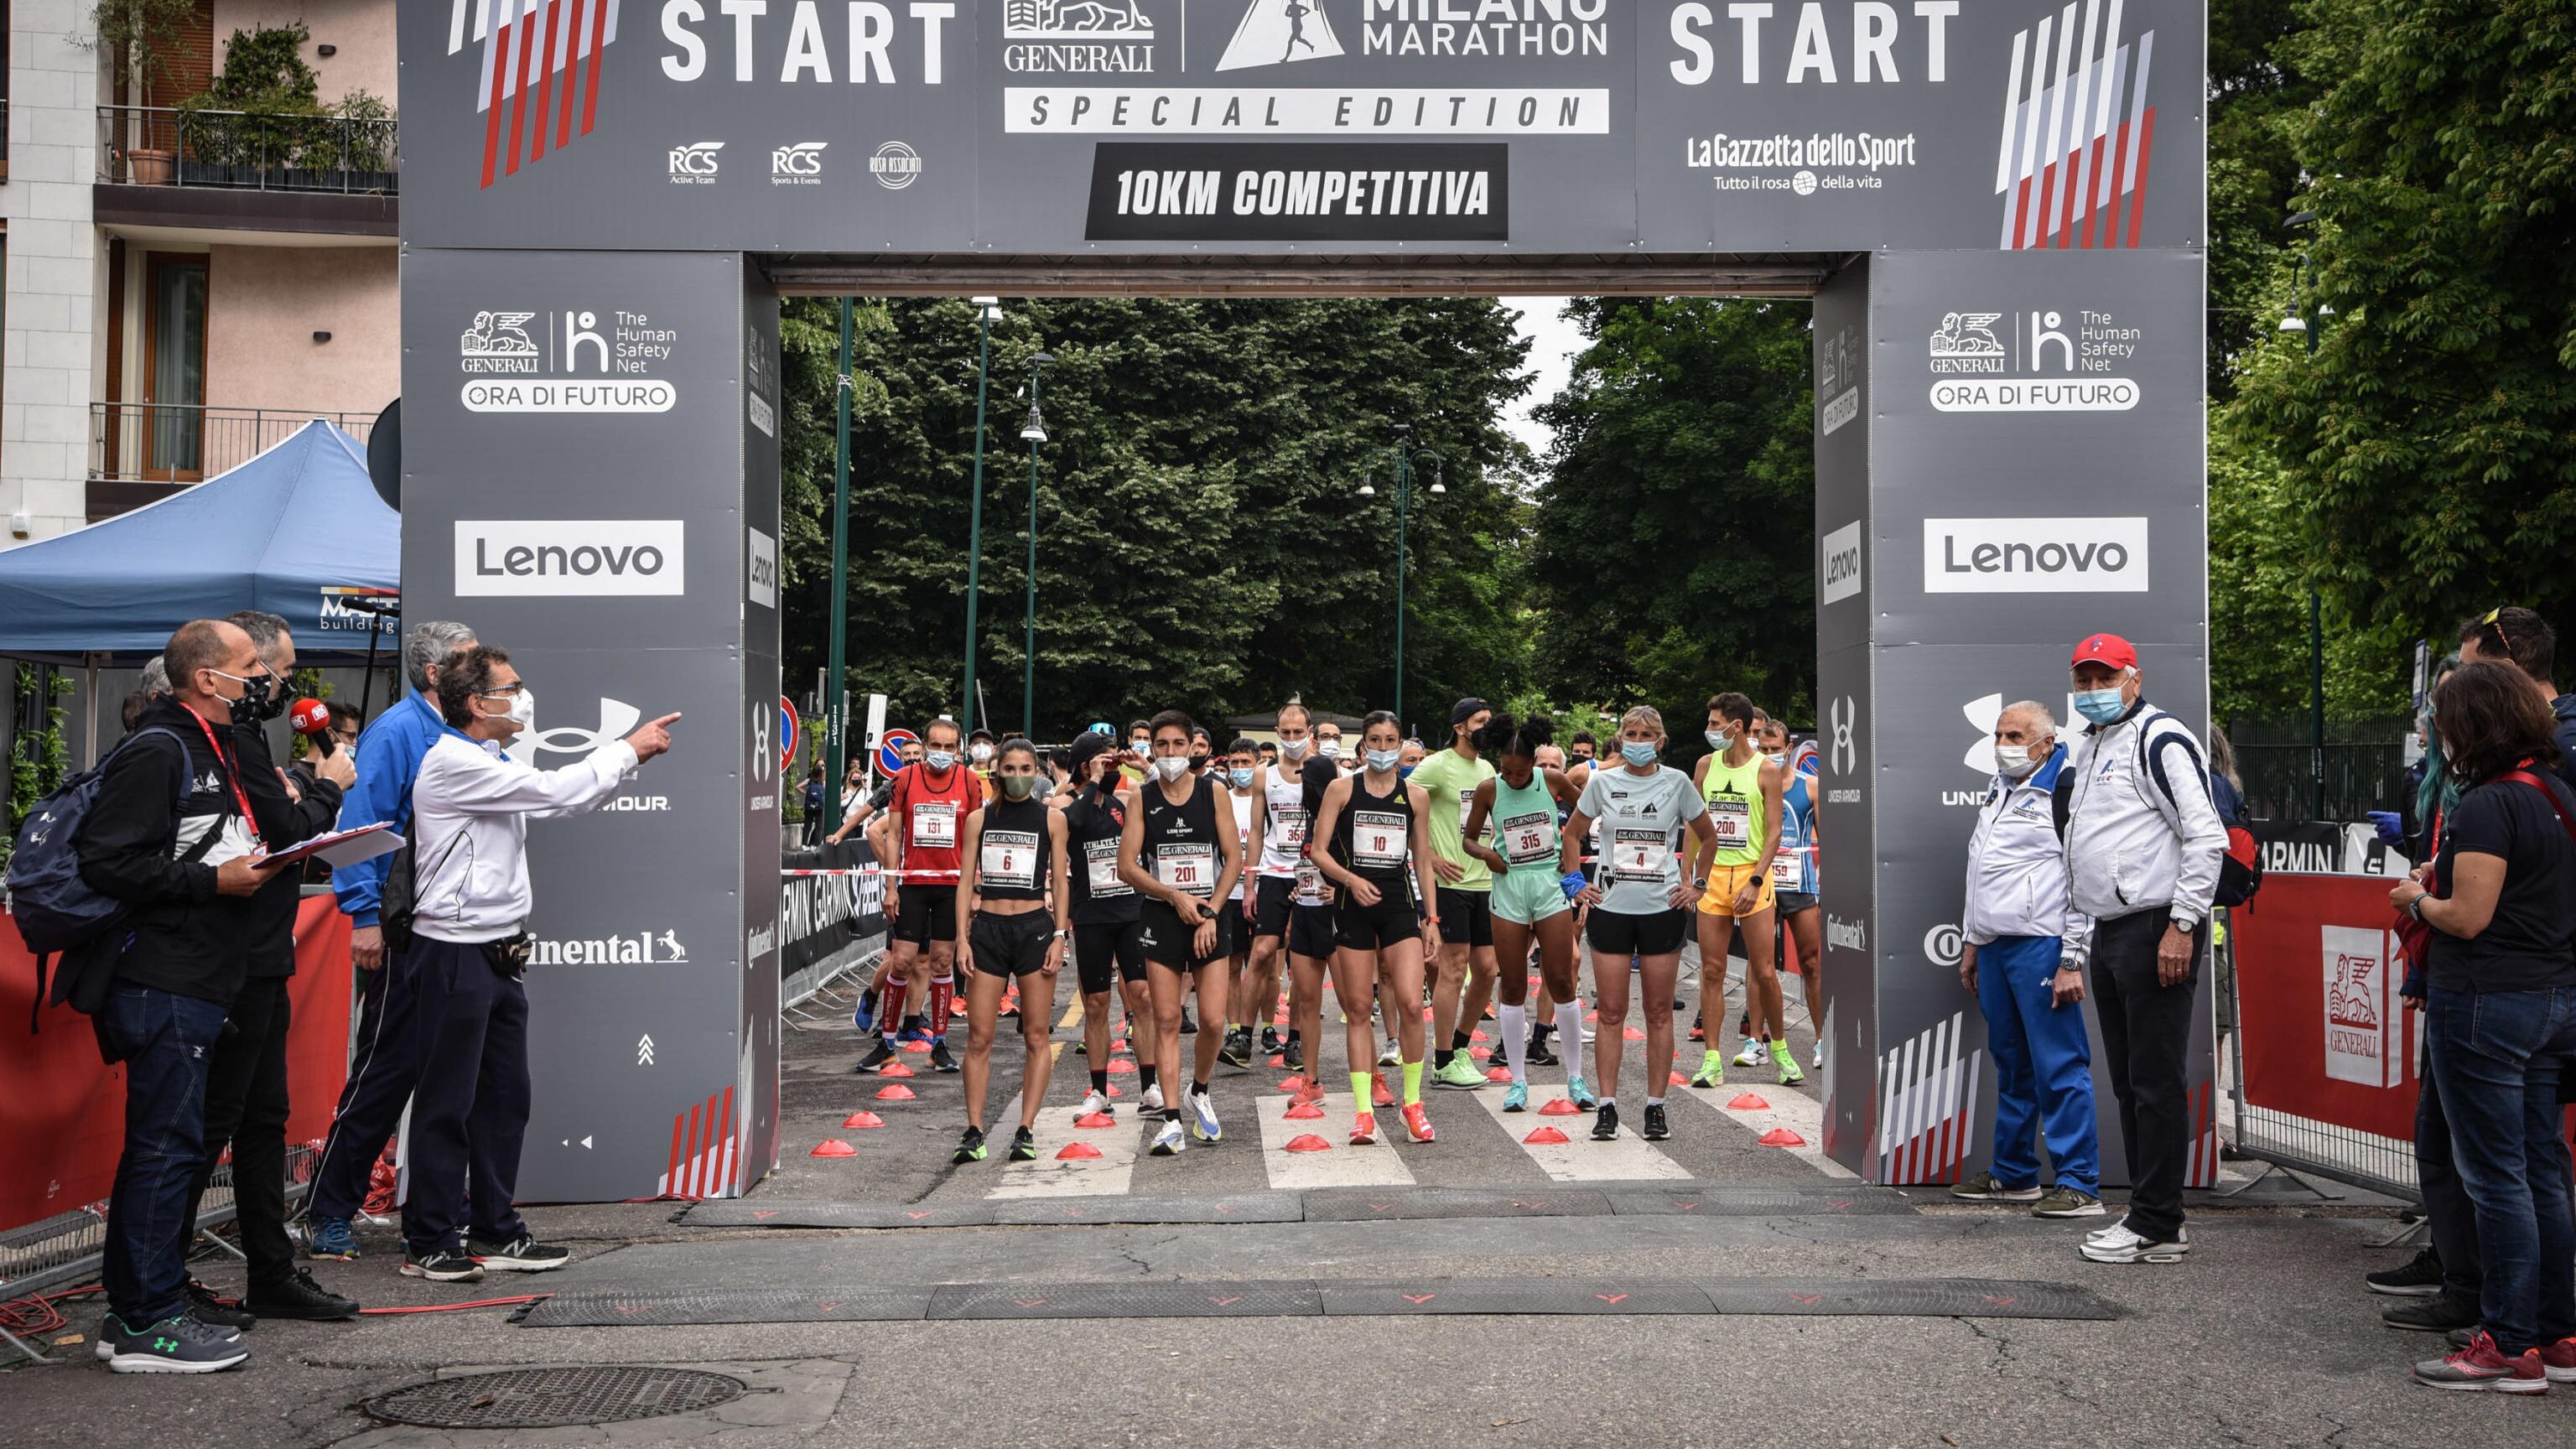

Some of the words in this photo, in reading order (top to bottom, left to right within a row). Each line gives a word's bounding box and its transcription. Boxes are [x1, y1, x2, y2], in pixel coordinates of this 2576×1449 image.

[661, 0, 955, 84] START
[1363, 23, 1607, 55] MARATHON
[1670, 1, 1959, 85] START
[1005, 45, 1154, 72] GENERALI
[1031, 96, 1280, 127] SPECIAL
[1335, 96, 1580, 127] EDITION
[1688, 138, 1711, 168] La
[1714, 132, 1802, 168] Gazzetta
[1806, 132, 1856, 167] dello
[1857, 132, 1916, 172] Sport
[668, 151, 719, 174] RCS
[771, 151, 821, 174] RCS
[870, 157, 886, 173] ROSA
[889, 157, 922, 173] ASSOCIATI
[670, 176, 693, 184] Active
[696, 176, 715, 184] Team
[771, 177, 792, 186] Sports
[801, 177, 821, 185] Events
[1714, 176, 1749, 190] Tutto
[1752, 175, 1759, 189] il
[1762, 178, 1790, 190] rosa
[1821, 174, 1853, 190] della
[1857, 175, 1883, 189] vita
[1118, 170, 1221, 216] 10KM
[1233, 170, 1488, 216] COMPETITIVA
[615, 311, 647, 325] The
[2080, 310, 2111, 325] The
[616, 328, 677, 341] Human
[2081, 326, 2140, 340] Human
[616, 342, 671, 361] Safety
[2080, 341, 2135, 359] Safety
[461, 358, 538, 373] GENERALI
[616, 359, 647, 373] Net
[1930, 358, 2005, 373] GENERALI
[2081, 357, 2111, 371] Net
[468, 386, 522, 406] ORA
[533, 386, 555, 406] DI
[565, 386, 668, 406] FUTURO
[1936, 385, 1989, 405] ORA
[1999, 386, 2021, 404] DI
[2031, 384, 2132, 404] FUTURO
[476, 538, 664, 576] Lenovo
[1944, 535, 2128, 574] Lenovo
[751, 543, 774, 589] Lenovo
[1826, 545, 1857, 586] Lenovo
[320, 617, 394, 634] building
[1828, 790, 1842, 802] UNDER
[1842, 789, 1861, 802] ARMOUR
[924, 806, 955, 814] GENERALI
[1716, 802, 1748, 812] GENERALI
[1368, 814, 1404, 825] GENERALI
[1514, 813, 1549, 825] GENERALI
[927, 822, 941, 834] 131
[1628, 830, 1665, 841] GENERALI
[1716, 821, 1735, 834] 200
[996, 834, 1036, 844] GENERALI
[1083, 839, 1114, 849] ATHLETIC
[1374, 835, 1386, 851] 10
[1521, 834, 1541, 849] 315
[1171, 845, 1210, 854] GENERALI
[1003, 854, 1011, 870] 6
[1637, 852, 1644, 867] 4
[1175, 866, 1197, 883] 201
[1827, 913, 1860, 952] Continental
[2330, 1028, 2377, 1059] GENERALI
